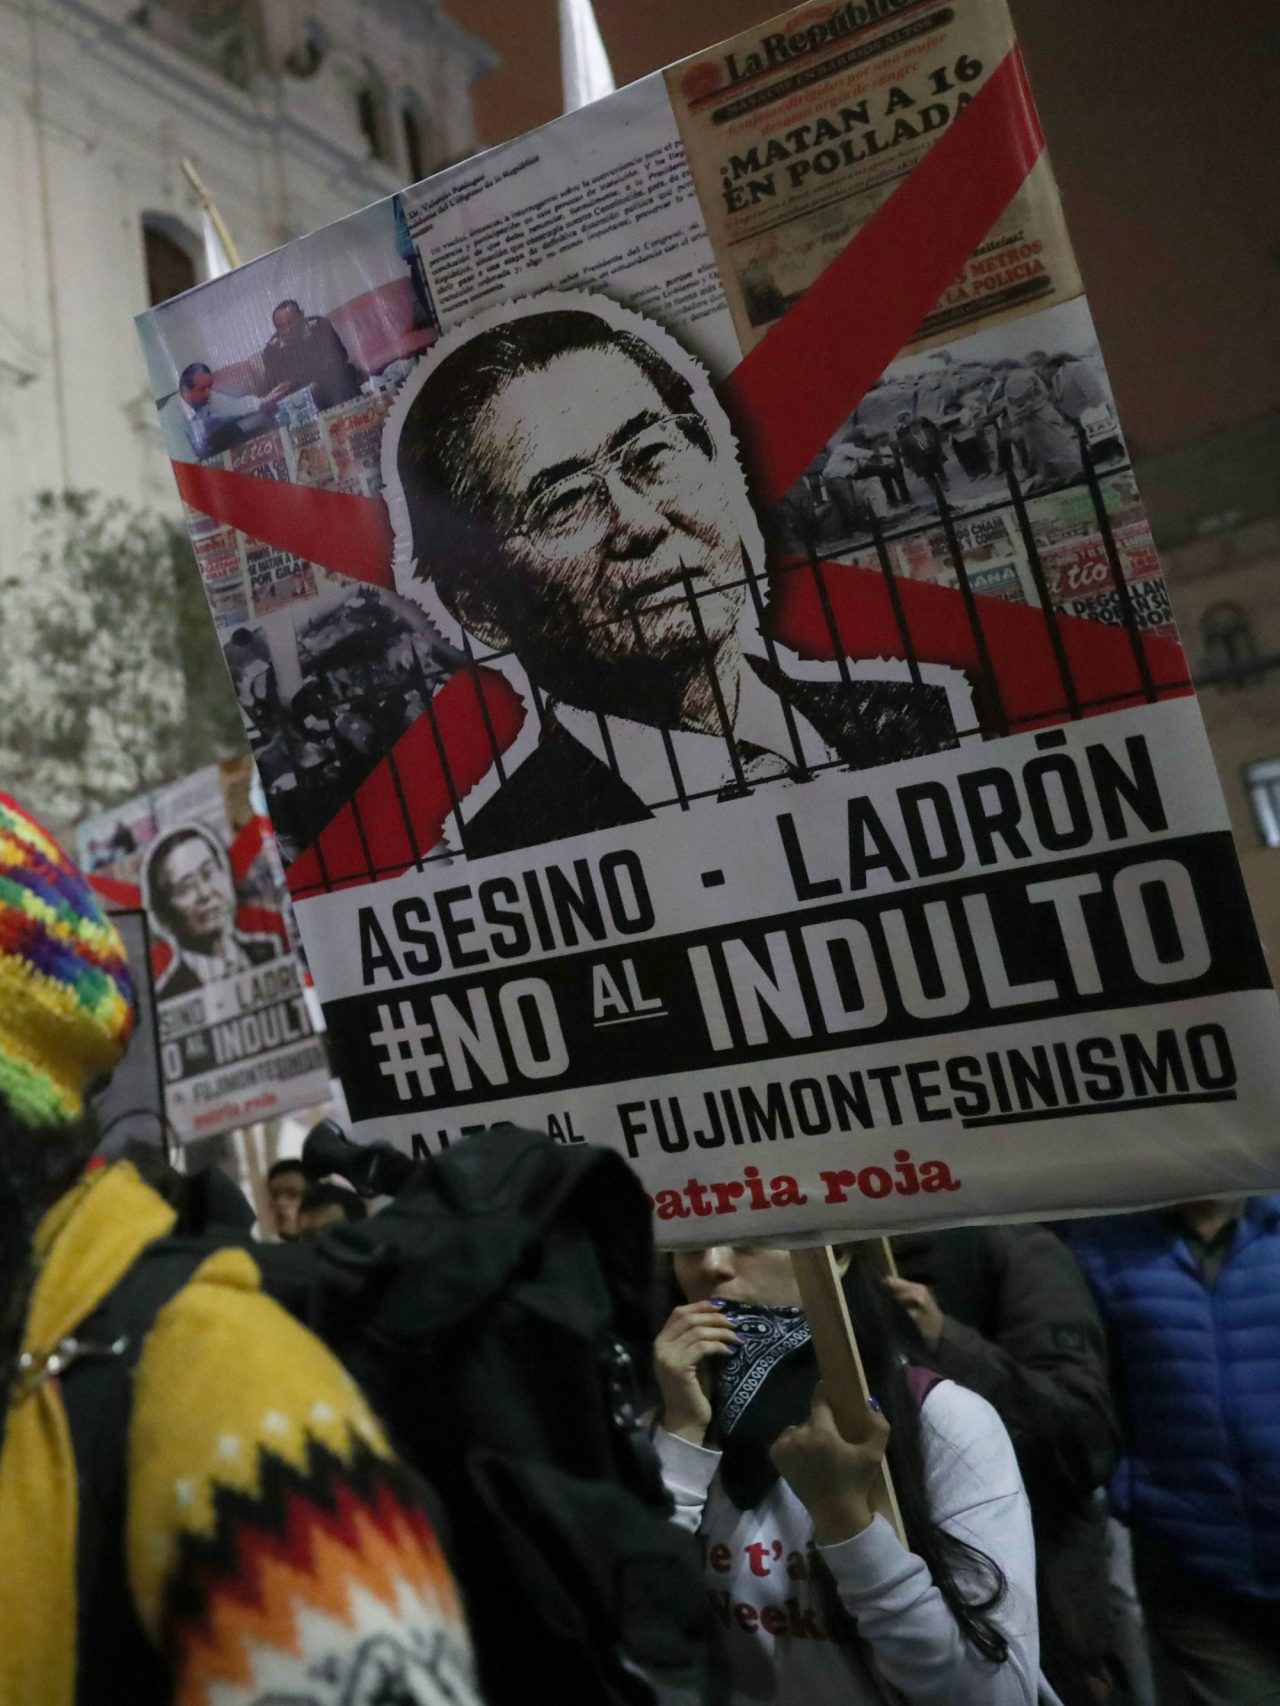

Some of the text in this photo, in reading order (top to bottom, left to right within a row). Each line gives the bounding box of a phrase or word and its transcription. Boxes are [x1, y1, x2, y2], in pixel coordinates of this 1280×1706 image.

[761, 0, 908, 65] Repúbli
[721, 100, 870, 190] ¡MATAN
[885, 86, 916, 115] A
[927, 54, 984, 96] 16
[721, 173, 776, 215] EN
[787, 92, 975, 188] POLLADA
[945, 287, 969, 305] LA
[973, 261, 1043, 294] POLICIA
[970, 242, 1041, 276] METROS
[250, 573, 272, 586] POR
[357, 848, 657, 986] ASESINO
[777, 730, 1169, 902] LADRÓN
[370, 977, 570, 1101] #NO
[592, 959, 664, 1019] AL
[686, 858, 1213, 1053] INDULTO
[411, 1023, 1238, 1159] AL AL FUJIMONTESINISMO
[647, 1149, 962, 1221] atria roja
